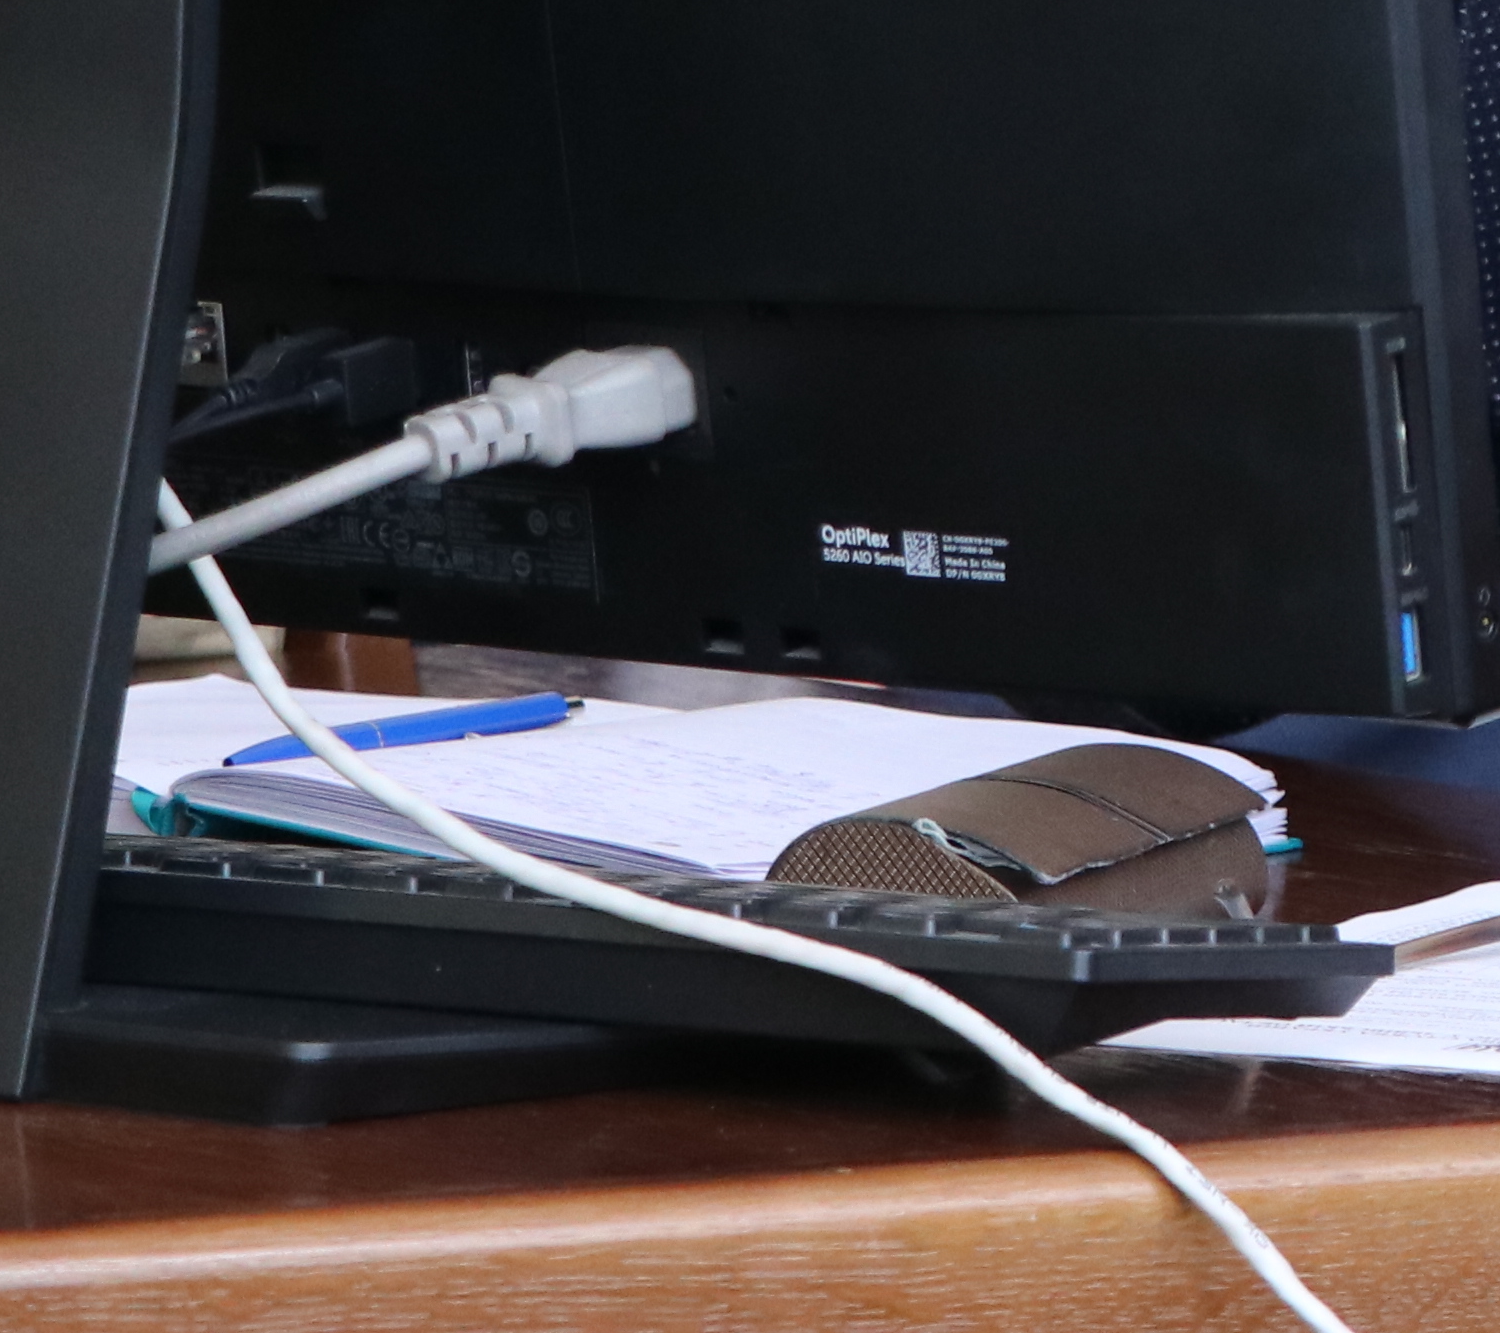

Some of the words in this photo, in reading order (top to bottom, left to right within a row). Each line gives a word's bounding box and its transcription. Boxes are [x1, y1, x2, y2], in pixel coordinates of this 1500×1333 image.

[821, 524, 890, 549] OptiPlex
[823, 548, 850, 563] 5260
[852, 550, 873, 565] AIO
[874, 552, 906, 568] Series
